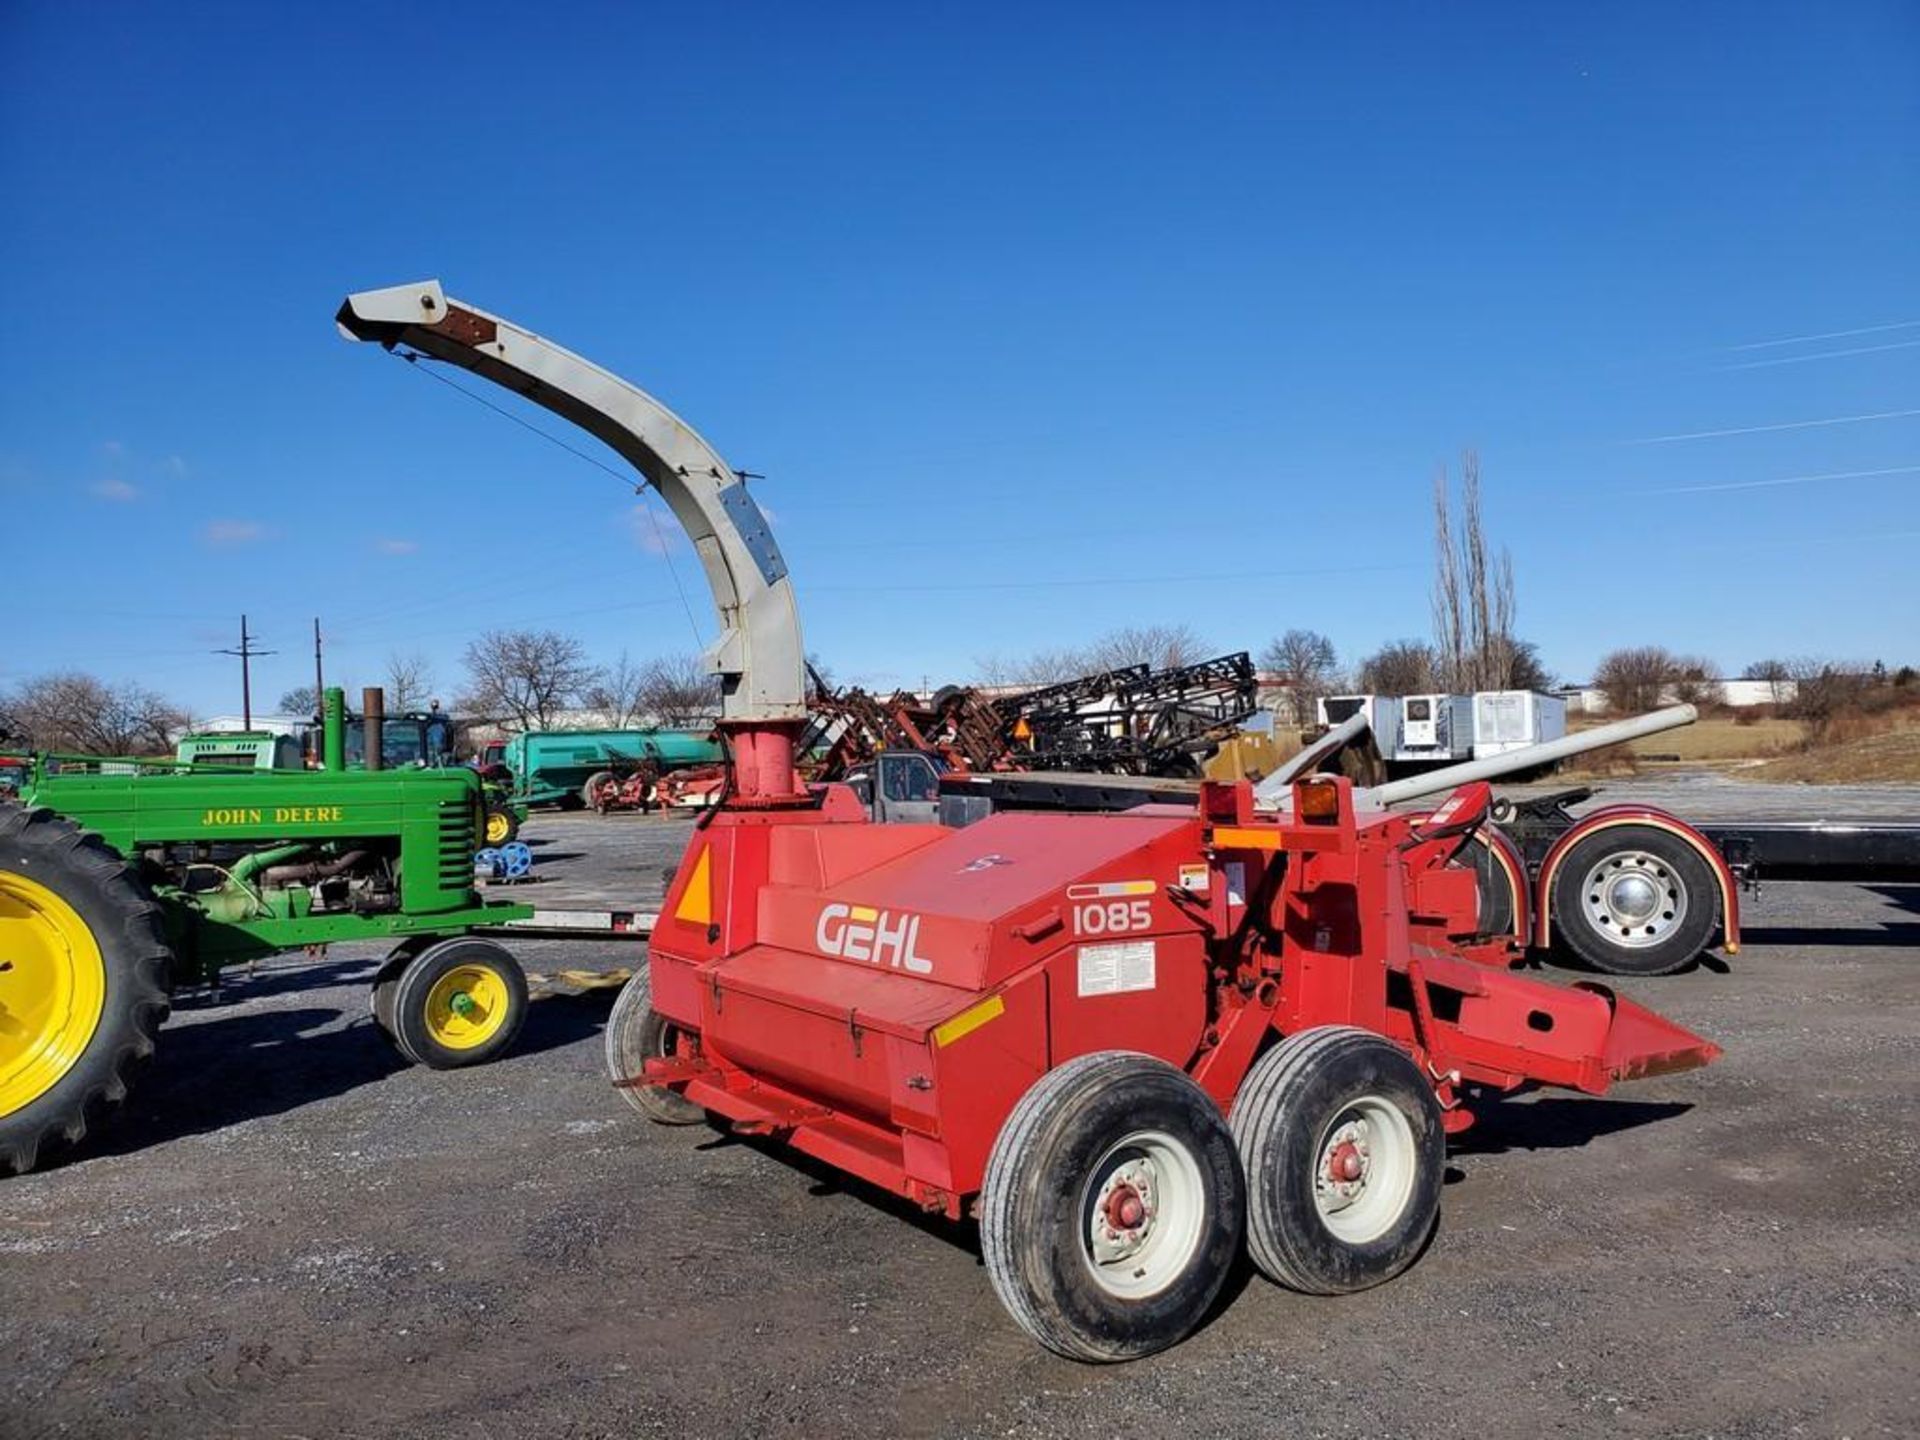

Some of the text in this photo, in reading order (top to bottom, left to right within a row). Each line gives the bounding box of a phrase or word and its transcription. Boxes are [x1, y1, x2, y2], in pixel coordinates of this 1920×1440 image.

[202, 806, 343, 826] JOHN DEERE
[1073, 900, 1152, 935] 1085
[816, 903, 933, 974] GEHL
